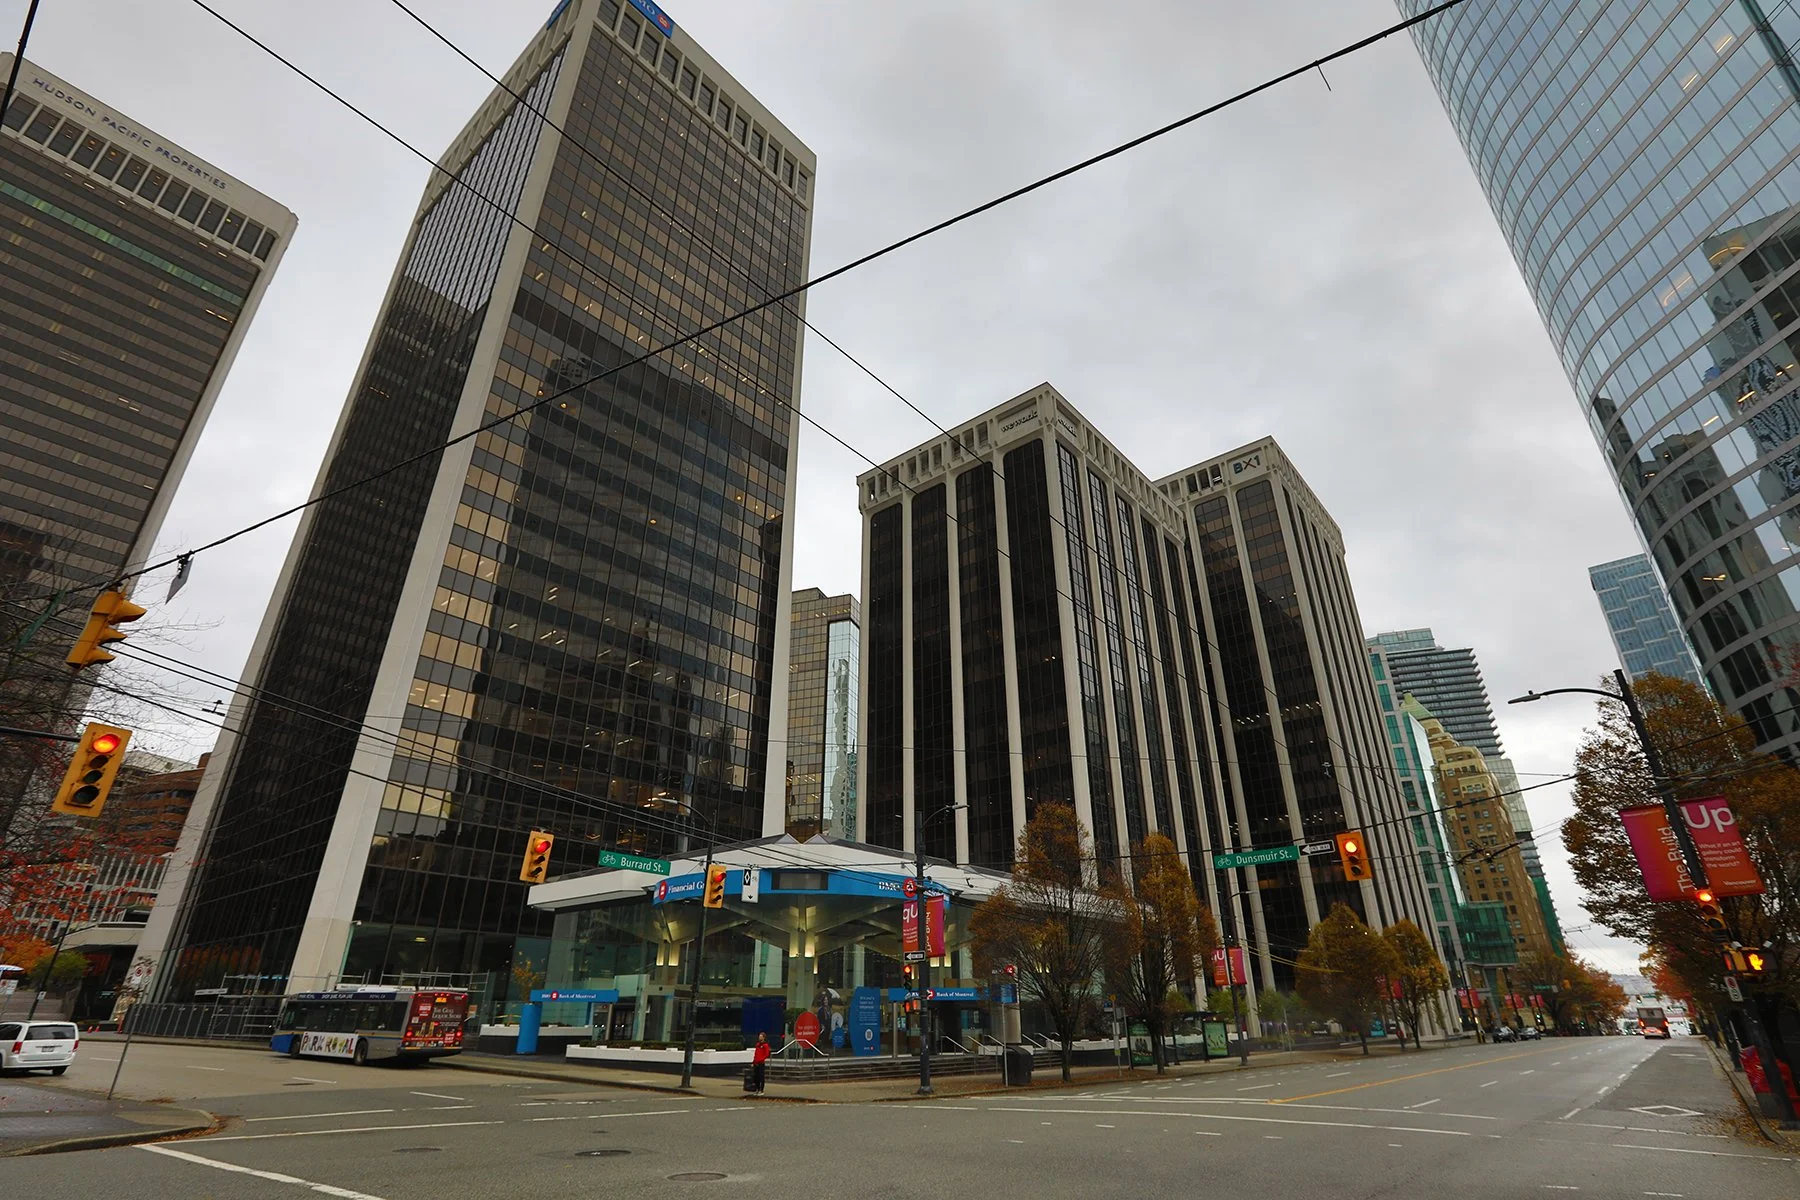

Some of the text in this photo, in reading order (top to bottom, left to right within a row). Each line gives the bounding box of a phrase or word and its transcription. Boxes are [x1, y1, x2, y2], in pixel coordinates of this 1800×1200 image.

[33, 78, 227, 190] HUDSON PACIFIC PROPERTIES
[1680, 804, 1736, 833] Up
[620, 858, 664, 873] Burrard St.
[1236, 850, 1292, 865] Dunsmuir St.
[1657, 826, 1697, 893] The Build
[668, 883, 695, 894] Financial
[301, 1033, 354, 1055] PARK ROYAL
